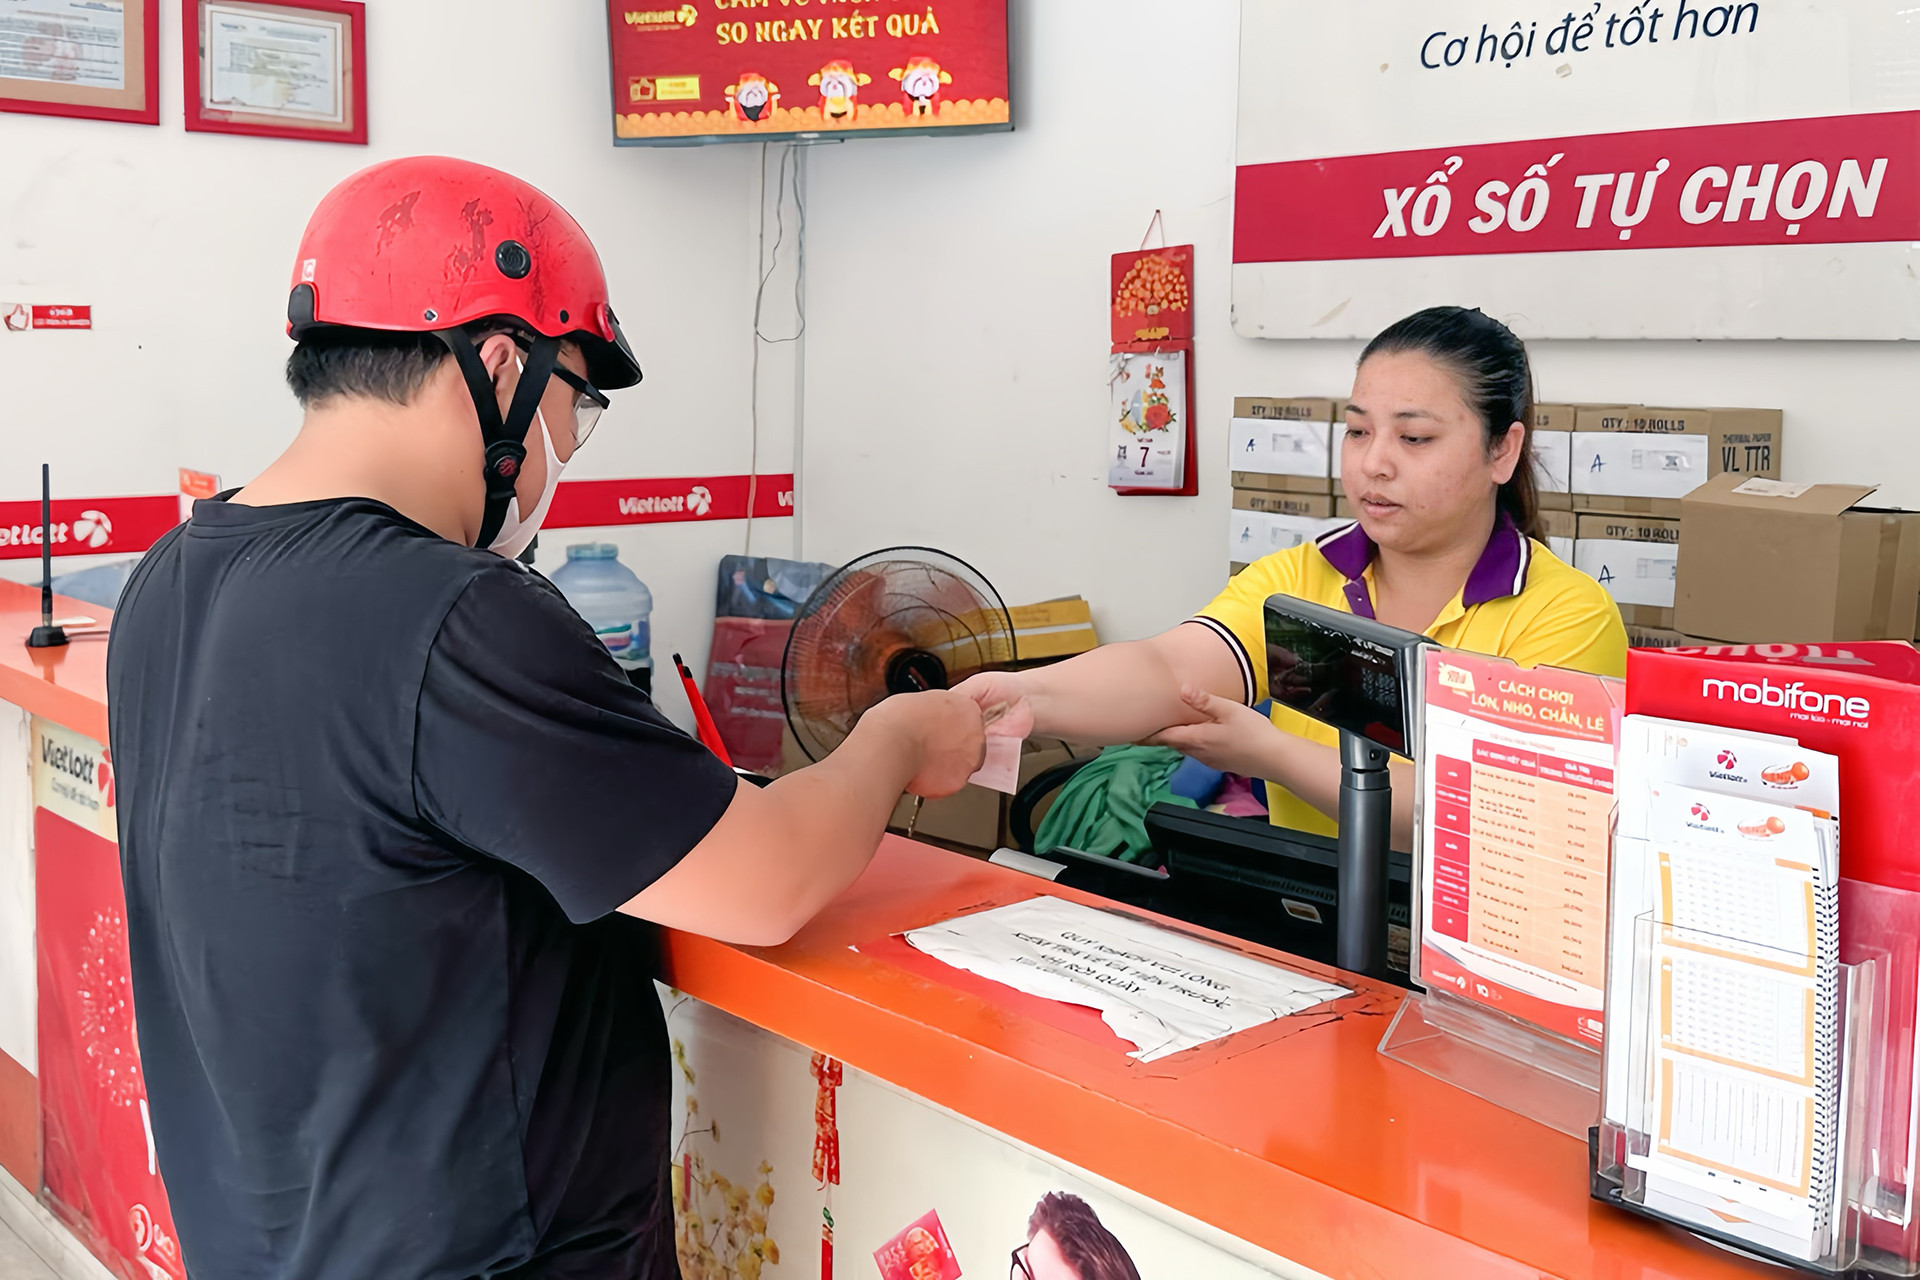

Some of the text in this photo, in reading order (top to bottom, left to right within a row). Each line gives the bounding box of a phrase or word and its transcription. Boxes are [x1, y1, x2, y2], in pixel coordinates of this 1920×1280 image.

[716, 22, 748, 45] SO
[755, 19, 823, 42] NGAY
[1420, 31, 1469, 69] Cơ
[1475, 20, 1537, 69] hội
[1545, 2, 1602, 56] để
[1673, 0, 1759, 41] hơn
[1373, 153, 1888, 240] XỔ SỐ TỰ CHỌN
[1602, 417, 1623, 429] QTY
[1140, 446, 1150, 468] 7
[1590, 453, 1607, 473] A
[1722, 445, 1770, 473] VL TTR
[1606, 525, 1627, 537] QTY
[1598, 564, 1615, 584] A
[1702, 677, 1870, 719] mobifone
[41, 734, 94, 784] Vietlott
